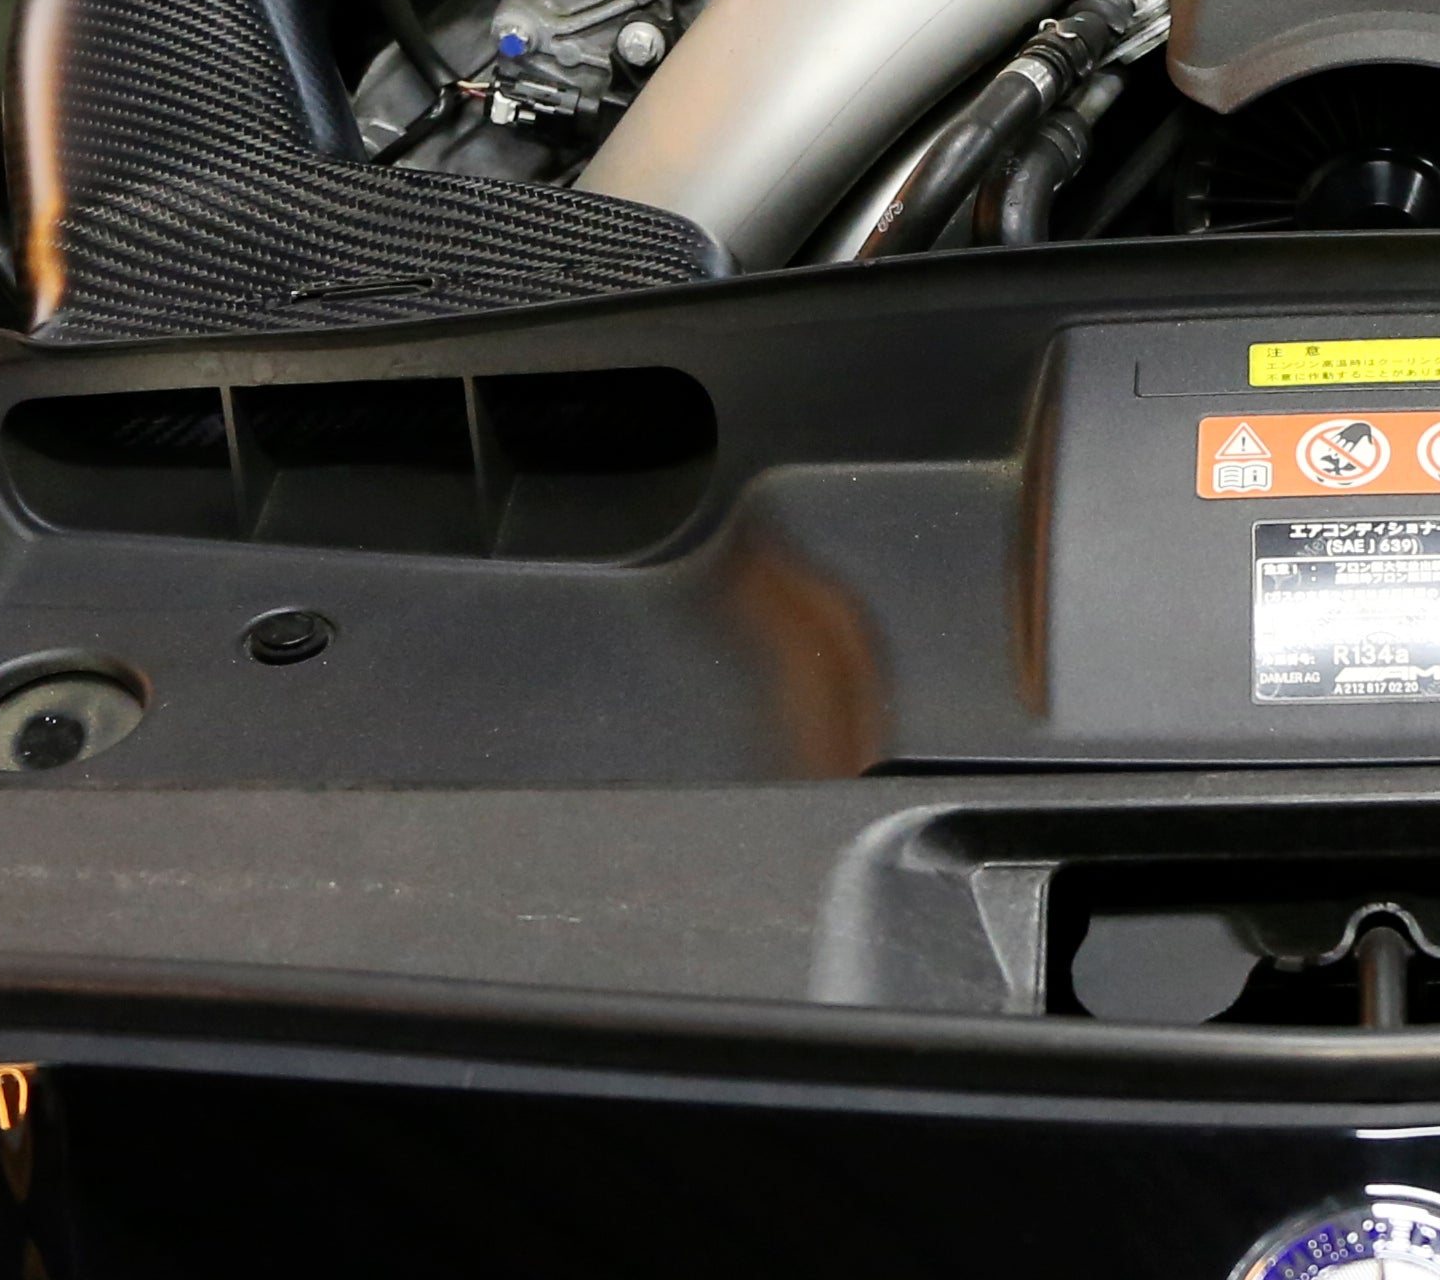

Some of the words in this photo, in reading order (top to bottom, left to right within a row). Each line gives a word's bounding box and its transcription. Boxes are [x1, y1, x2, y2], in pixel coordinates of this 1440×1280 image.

[1326, 539, 1364, 556] (SAE
[1368, 539, 1376, 554] J
[1379, 537, 1419, 555] 639)
[1333, 643, 1410, 665] R134a
[1259, 672, 1303, 684] DAIMLER
[1304, 671, 1321, 683] AG
[1333, 683, 1345, 694] A
[1345, 683, 1365, 694] 212
[1388, 682, 1404, 693] 02
[1404, 681, 1419, 692] 20
